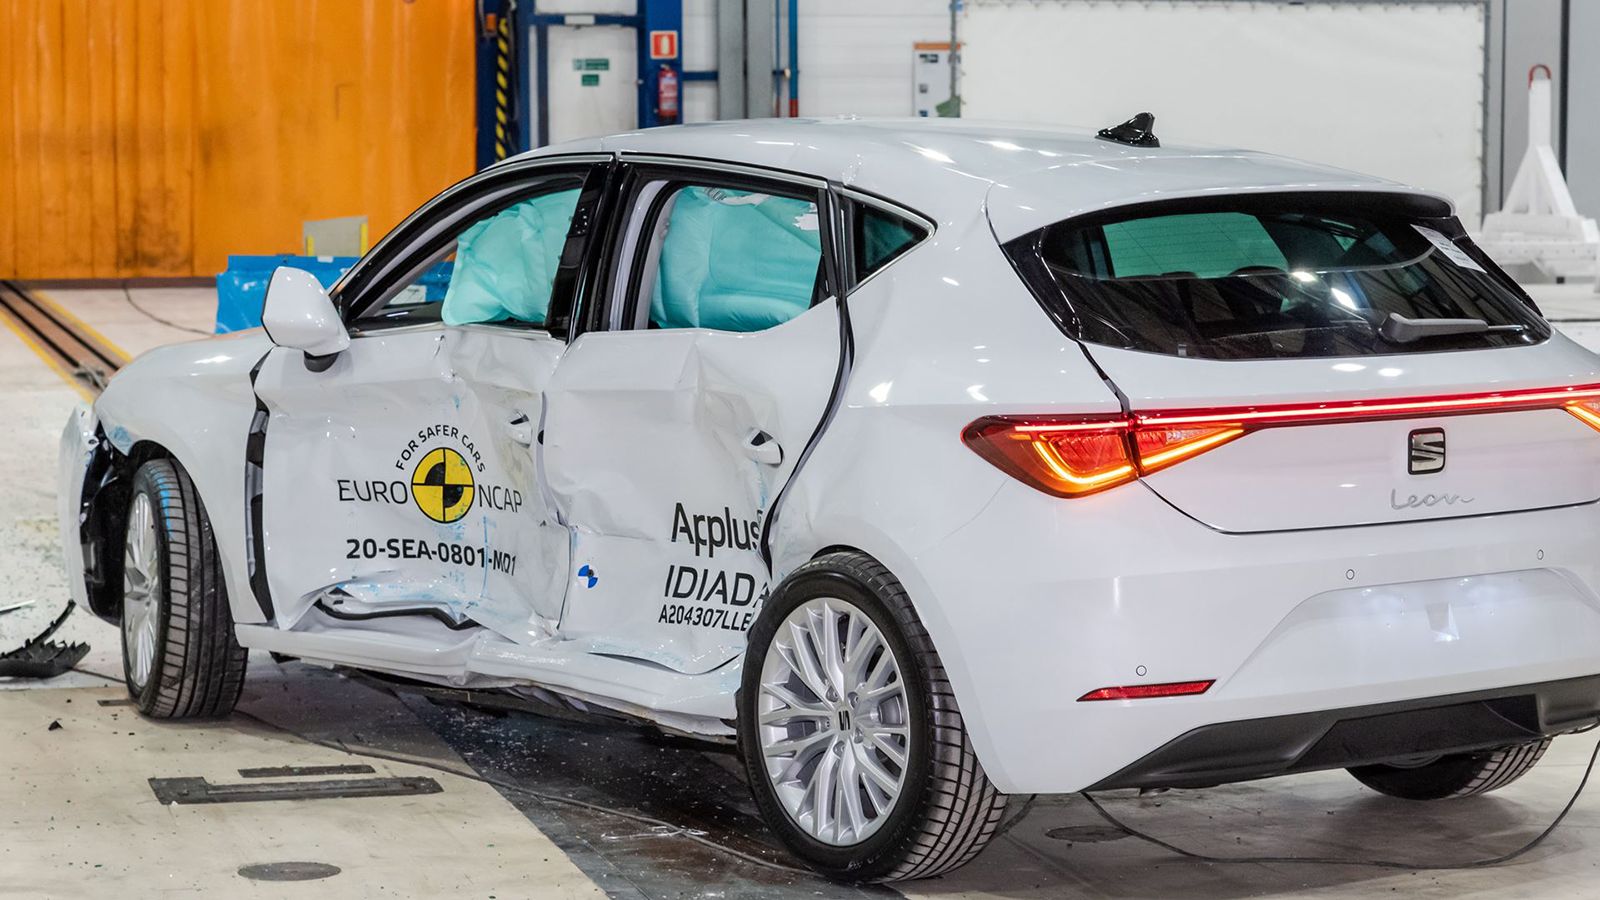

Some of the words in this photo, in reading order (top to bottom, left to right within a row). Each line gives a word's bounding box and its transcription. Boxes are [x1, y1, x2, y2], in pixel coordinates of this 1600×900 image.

[395, 439, 419, 471] FOR
[418, 424, 459, 443] SAFER
[461, 434, 486, 473] CARS
[337, 479, 409, 504] EURO
[478, 484, 523, 513] NCAP
[1390, 488, 1475, 510] Leon
